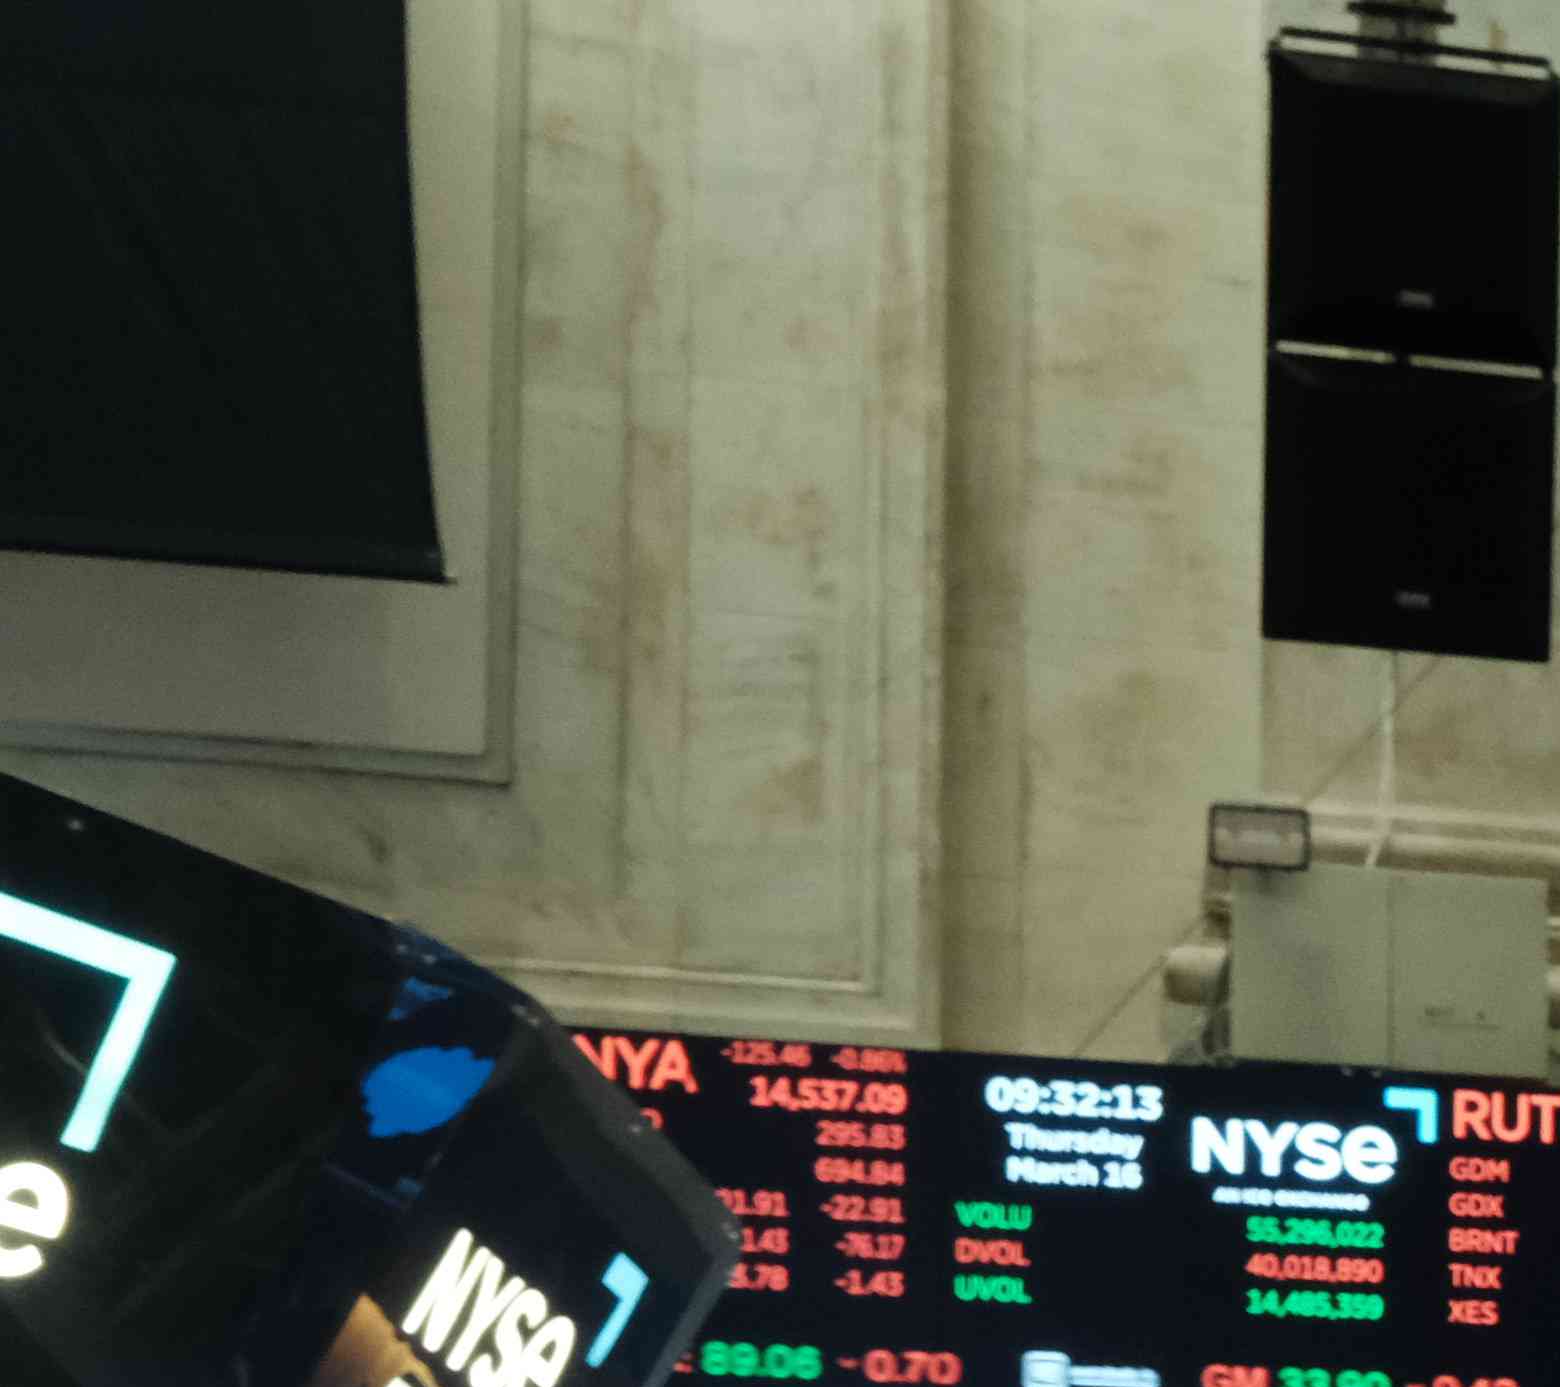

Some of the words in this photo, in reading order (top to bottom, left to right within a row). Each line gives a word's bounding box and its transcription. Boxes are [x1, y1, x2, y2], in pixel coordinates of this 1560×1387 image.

[750, 1076, 908, 1114] 14,537.09
[985, 1076, 1164, 1122] 09:32:13
[1004, 1122, 1145, 1160] Thursday
[1005, 1156, 1099, 1187] March
[1102, 1162, 1143, 1190] 16
